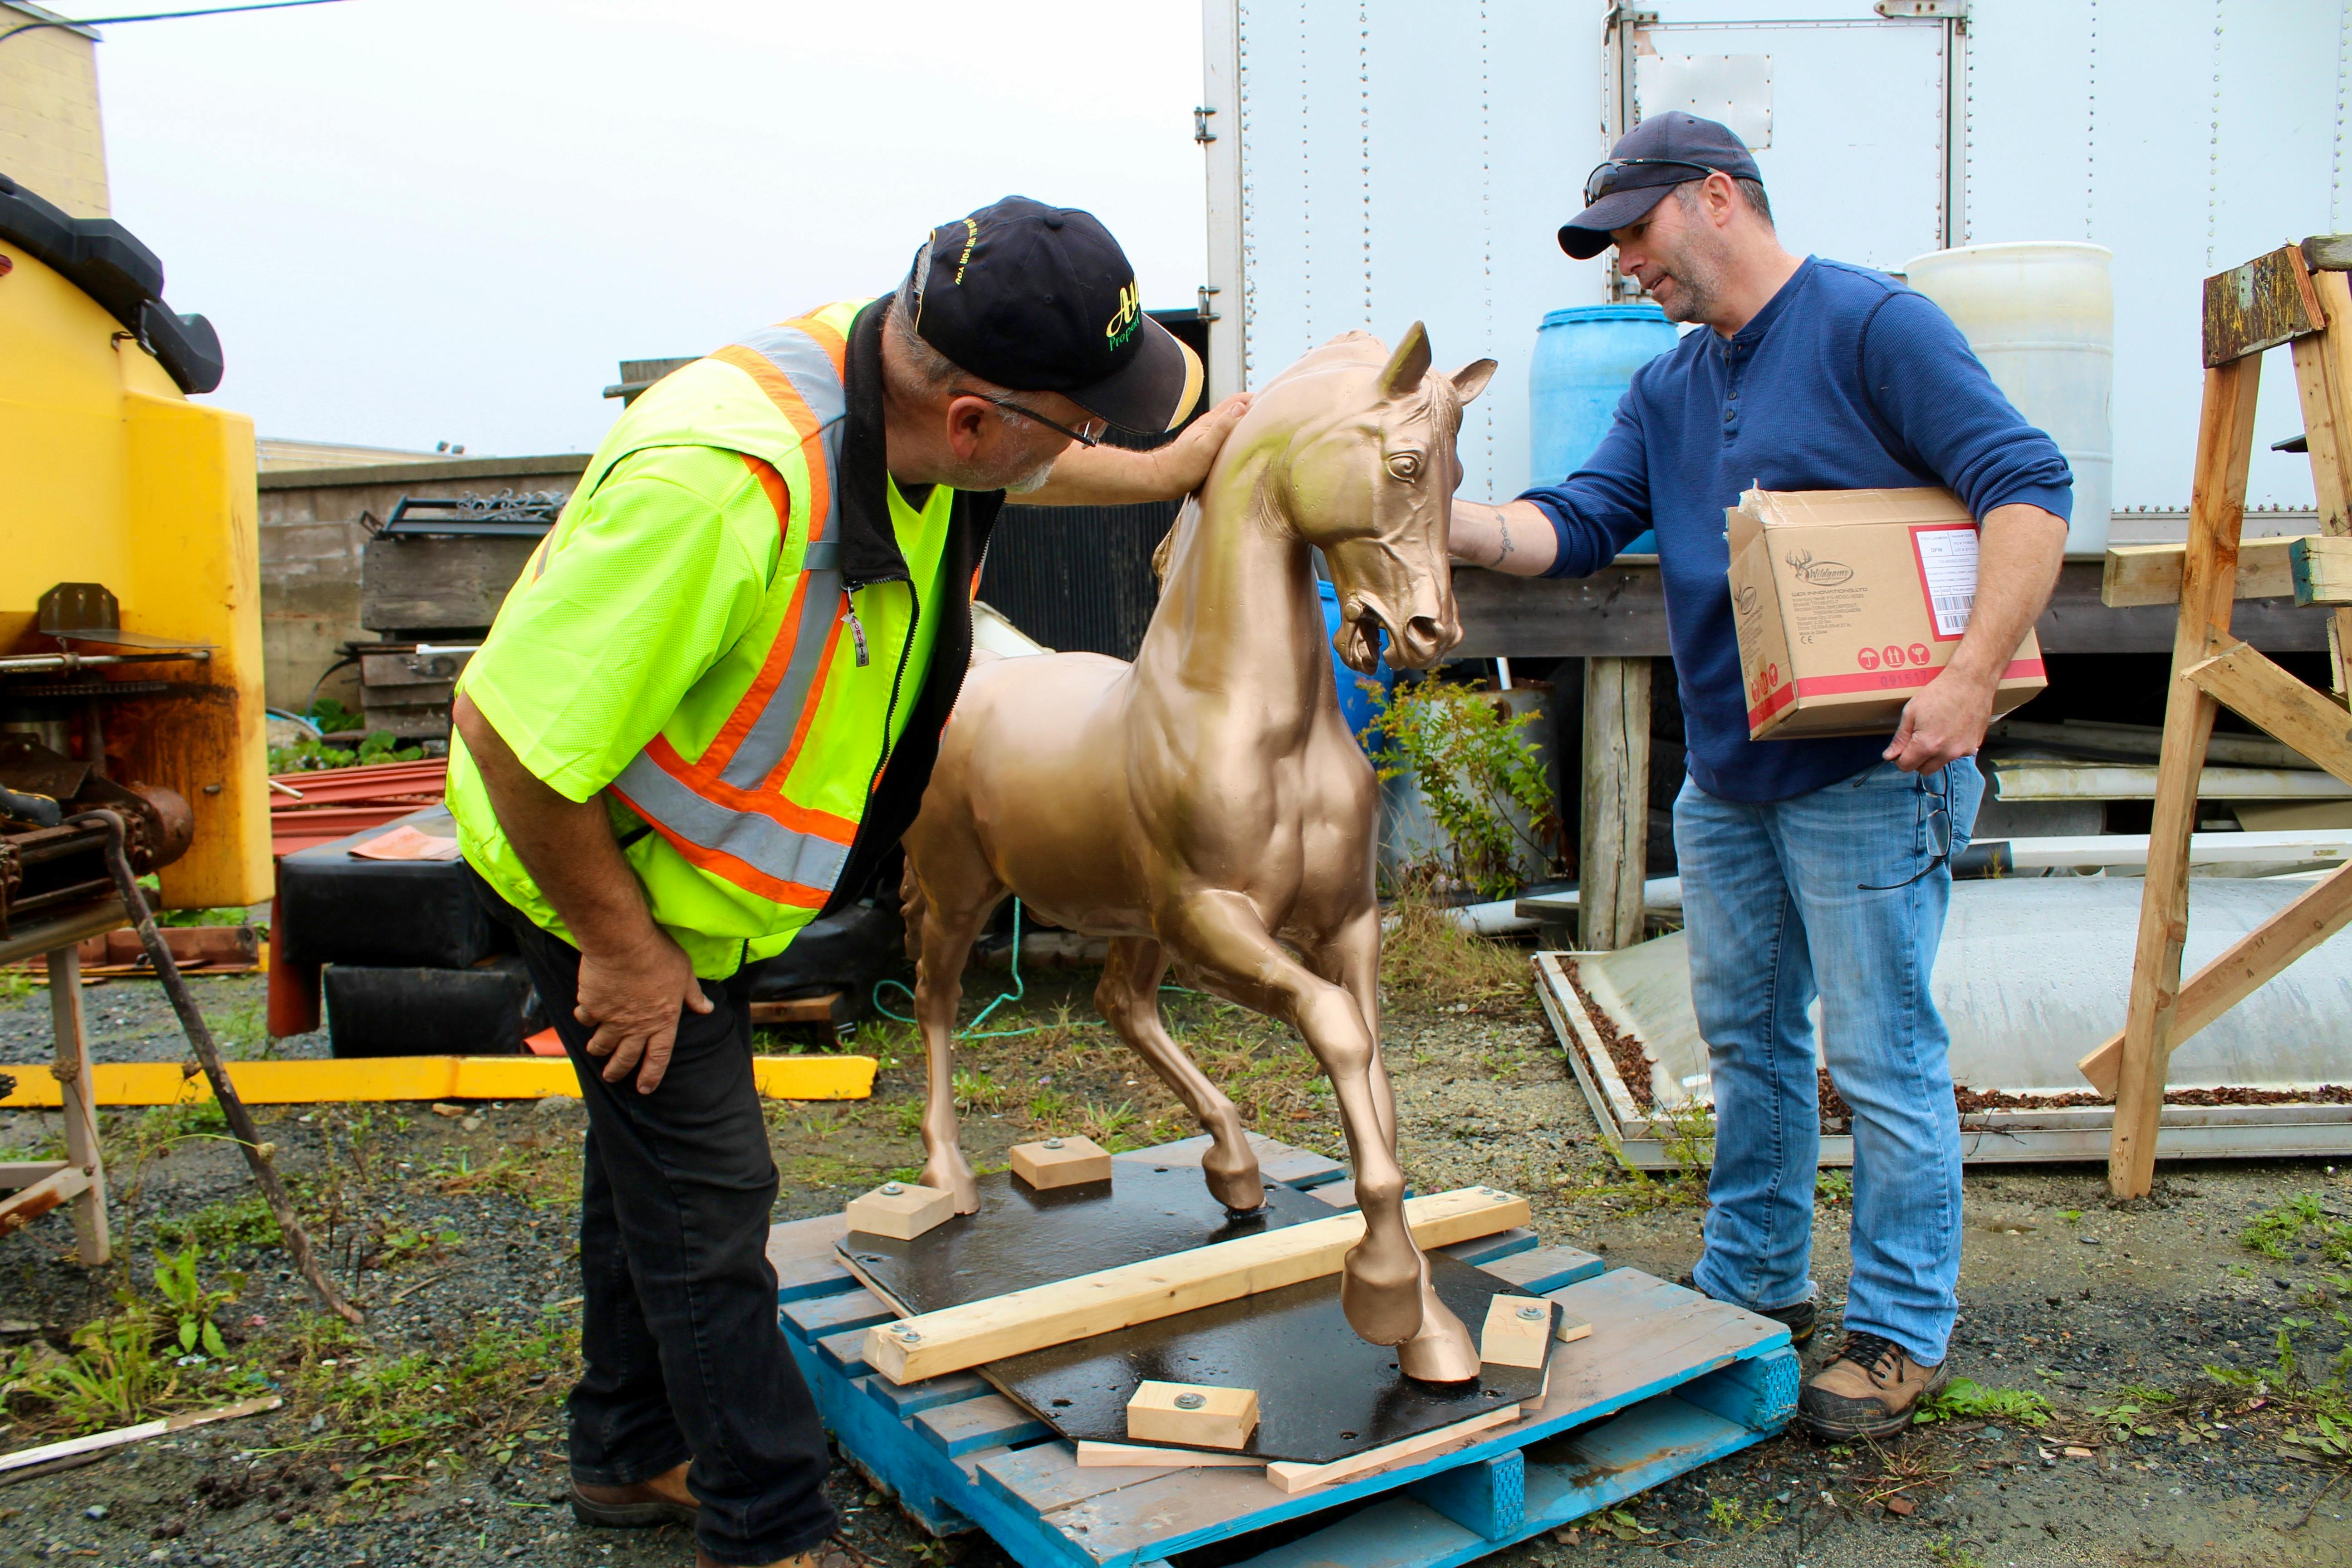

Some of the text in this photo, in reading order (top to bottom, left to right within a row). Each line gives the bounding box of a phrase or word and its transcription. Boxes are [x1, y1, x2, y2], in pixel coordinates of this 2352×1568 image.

[960, 249, 971, 264] FOR
[955, 266, 965, 285] YOU
[1881, 671, 1926, 686] 091517
